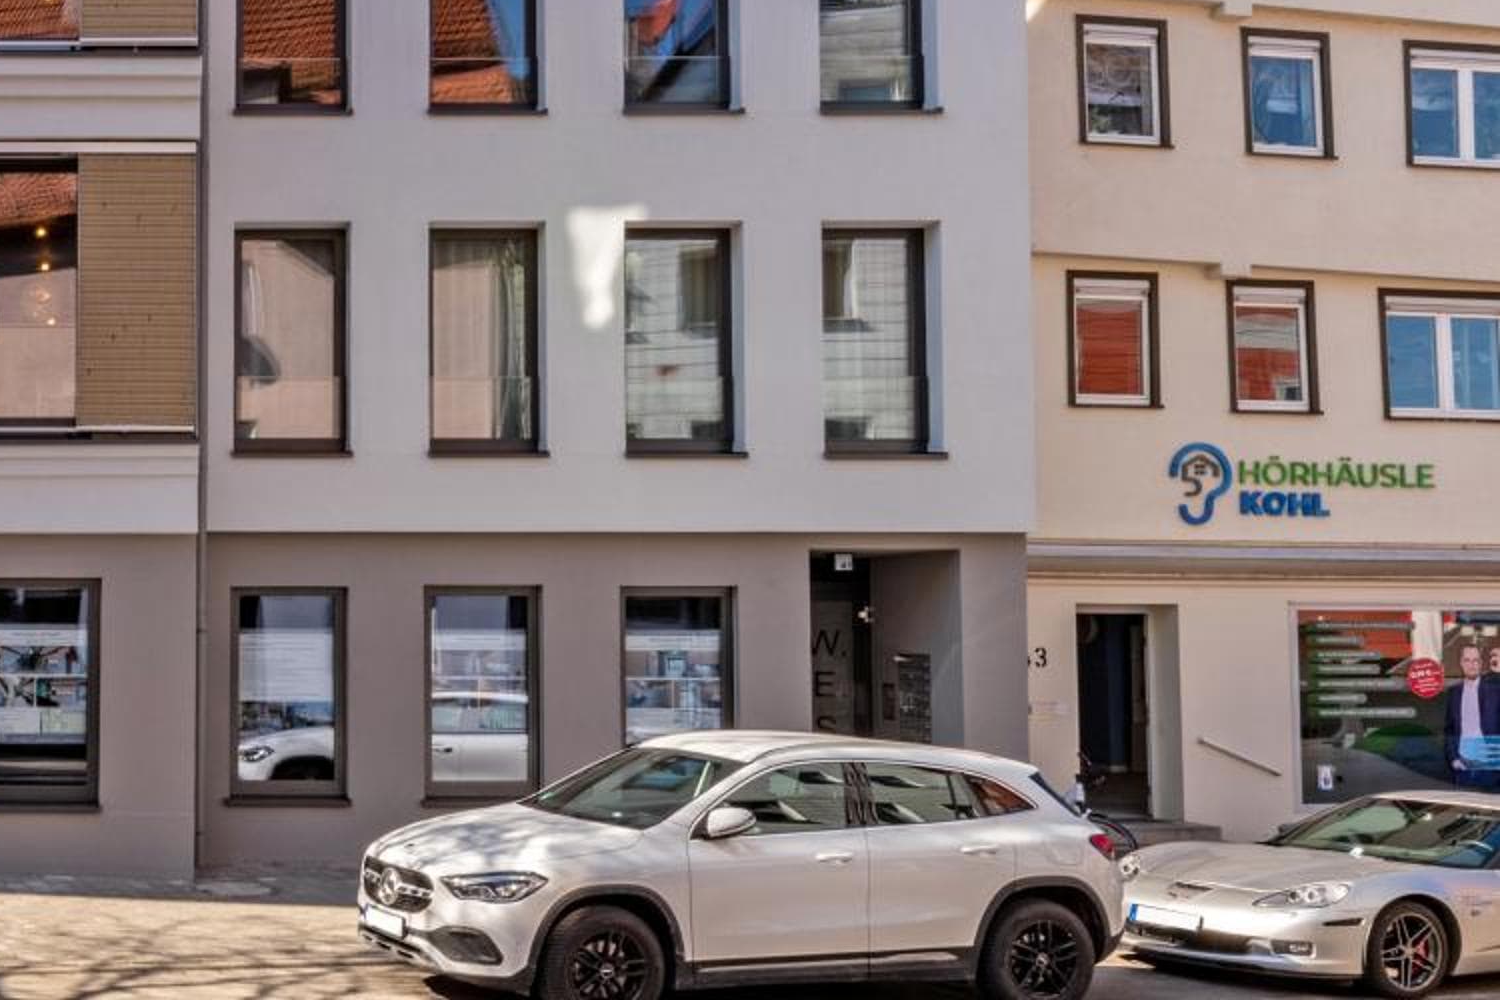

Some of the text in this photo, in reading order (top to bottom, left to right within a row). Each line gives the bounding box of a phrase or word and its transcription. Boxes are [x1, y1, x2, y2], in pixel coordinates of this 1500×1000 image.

[1238, 455, 1435, 489] HÖRHÄUSLE
[1239, 491, 1330, 516] KOHL
[1028, 647, 1047, 668] 3
